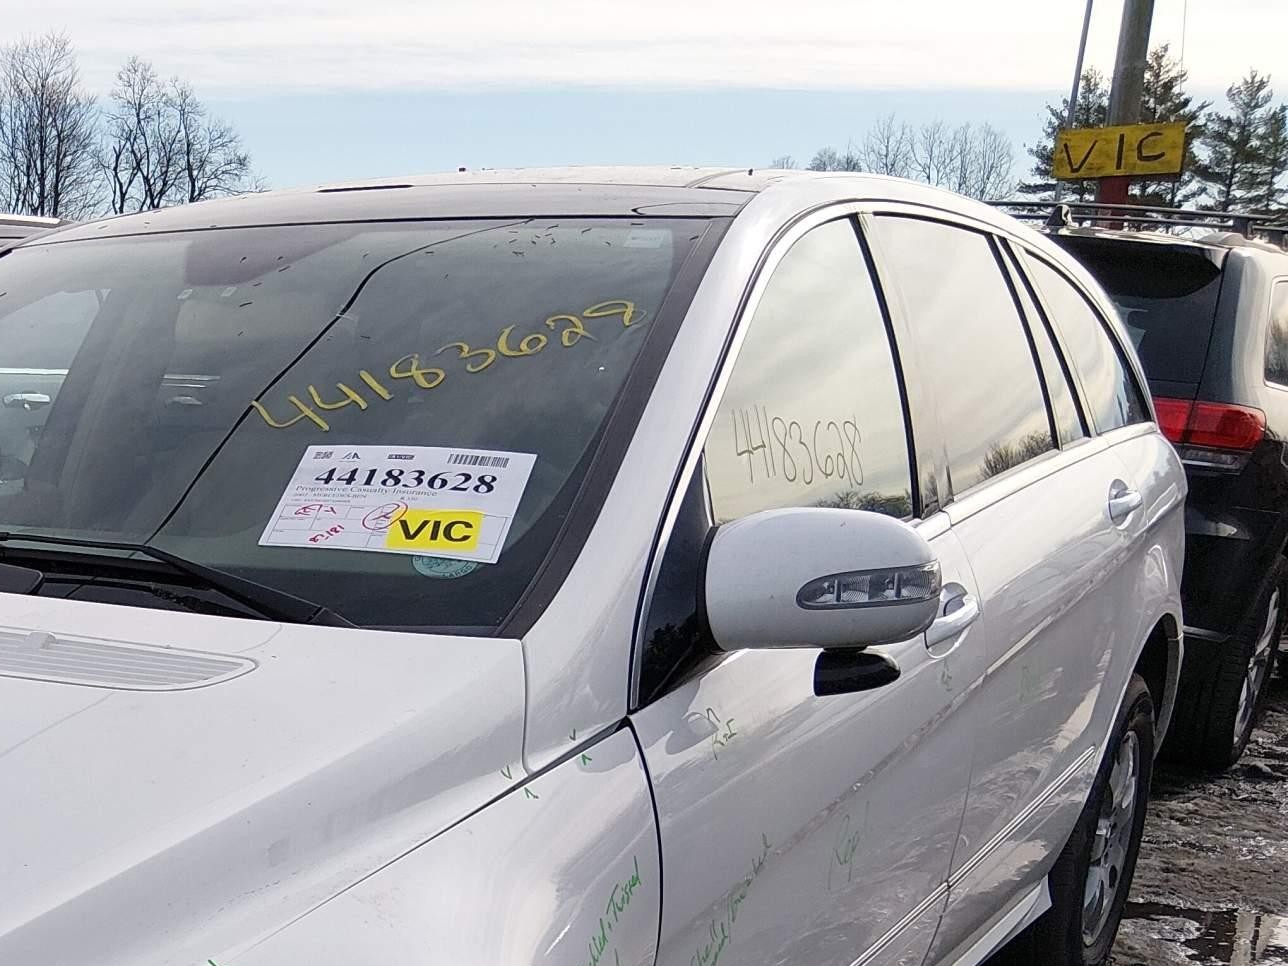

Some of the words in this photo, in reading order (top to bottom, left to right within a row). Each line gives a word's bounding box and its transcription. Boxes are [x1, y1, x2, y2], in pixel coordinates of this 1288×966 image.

[1063, 132, 1166, 174] VIC
[730, 403, 864, 488] 44183628
[295, 485, 348, 493] Progressive
[350, 486, 388, 495] Casualty
[392, 488, 438, 497] Insurance
[313, 466, 498, 494] 44183628
[398, 518, 474, 542] VIC
